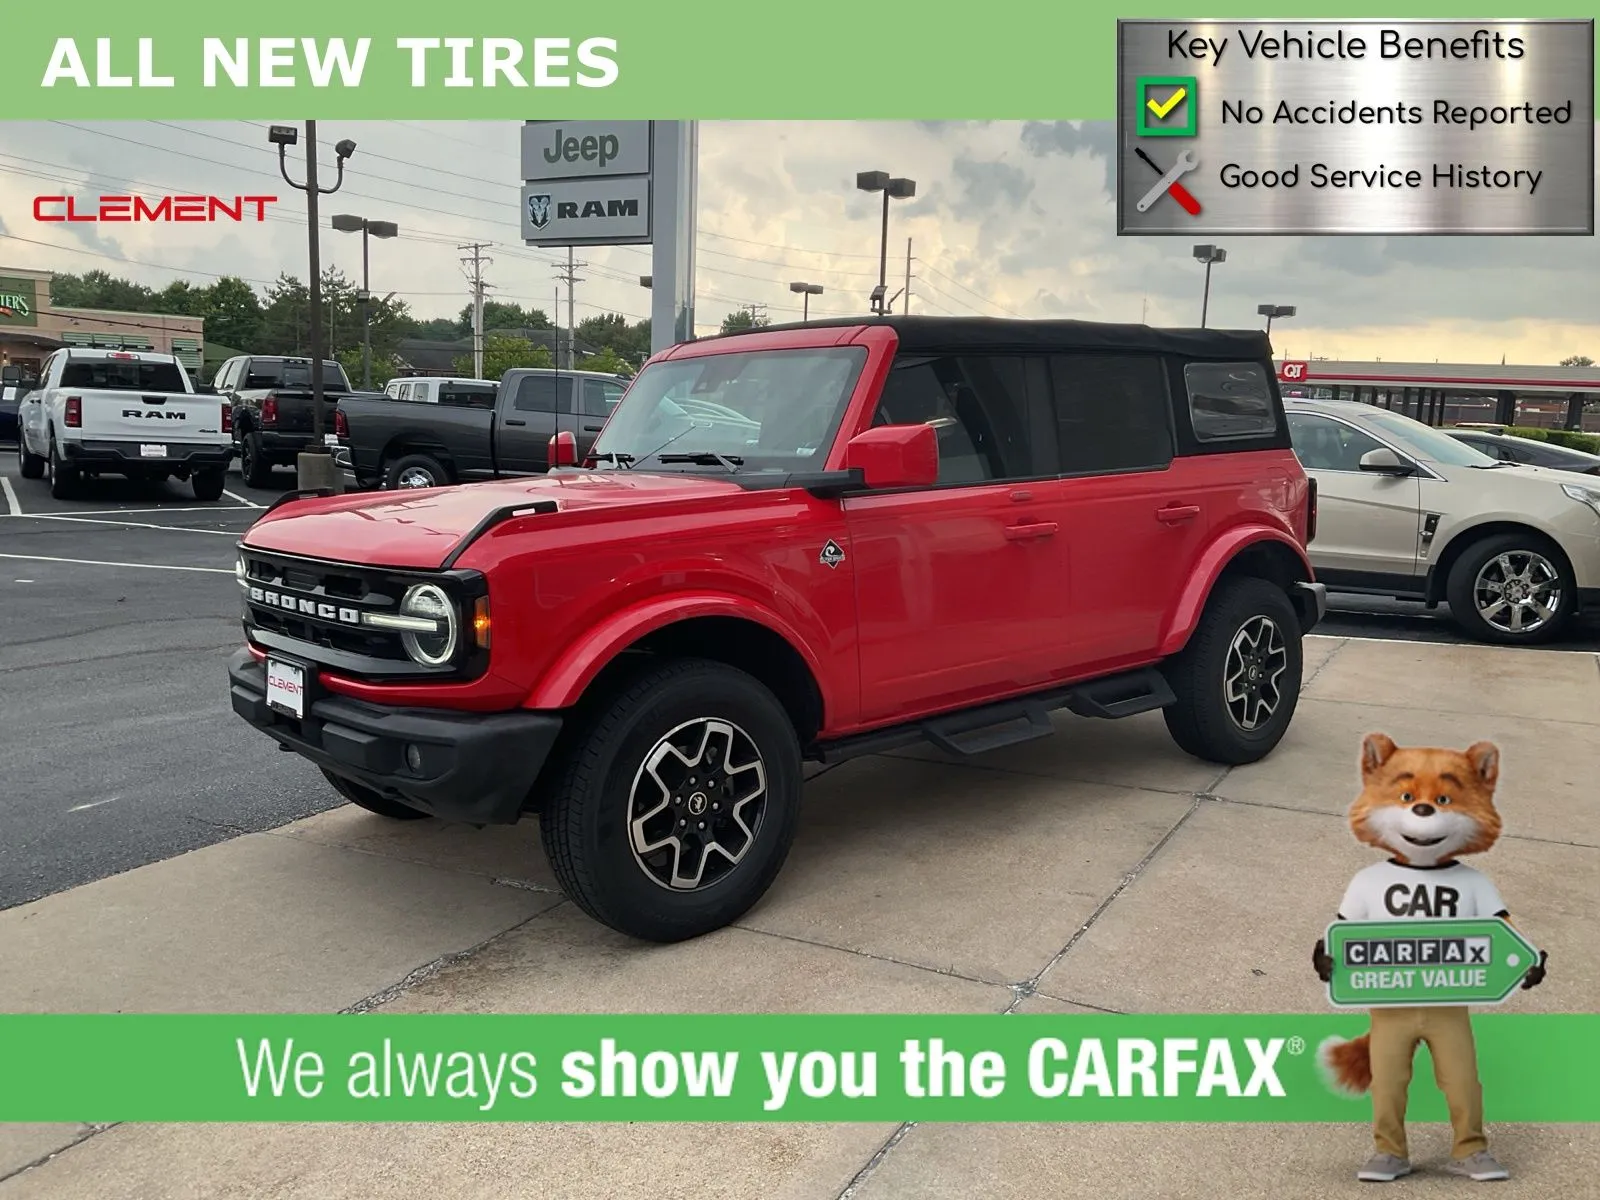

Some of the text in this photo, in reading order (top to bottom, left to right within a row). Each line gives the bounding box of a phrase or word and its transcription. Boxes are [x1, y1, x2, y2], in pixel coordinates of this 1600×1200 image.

[543, 129, 619, 168] Jeep
[557, 199, 638, 219] RAM
[1284, 364, 1303, 378] QT
[122, 409, 186, 420] RAM
[251, 587, 359, 624] BRONCO
[269, 675, 303, 696] CLEMENT
